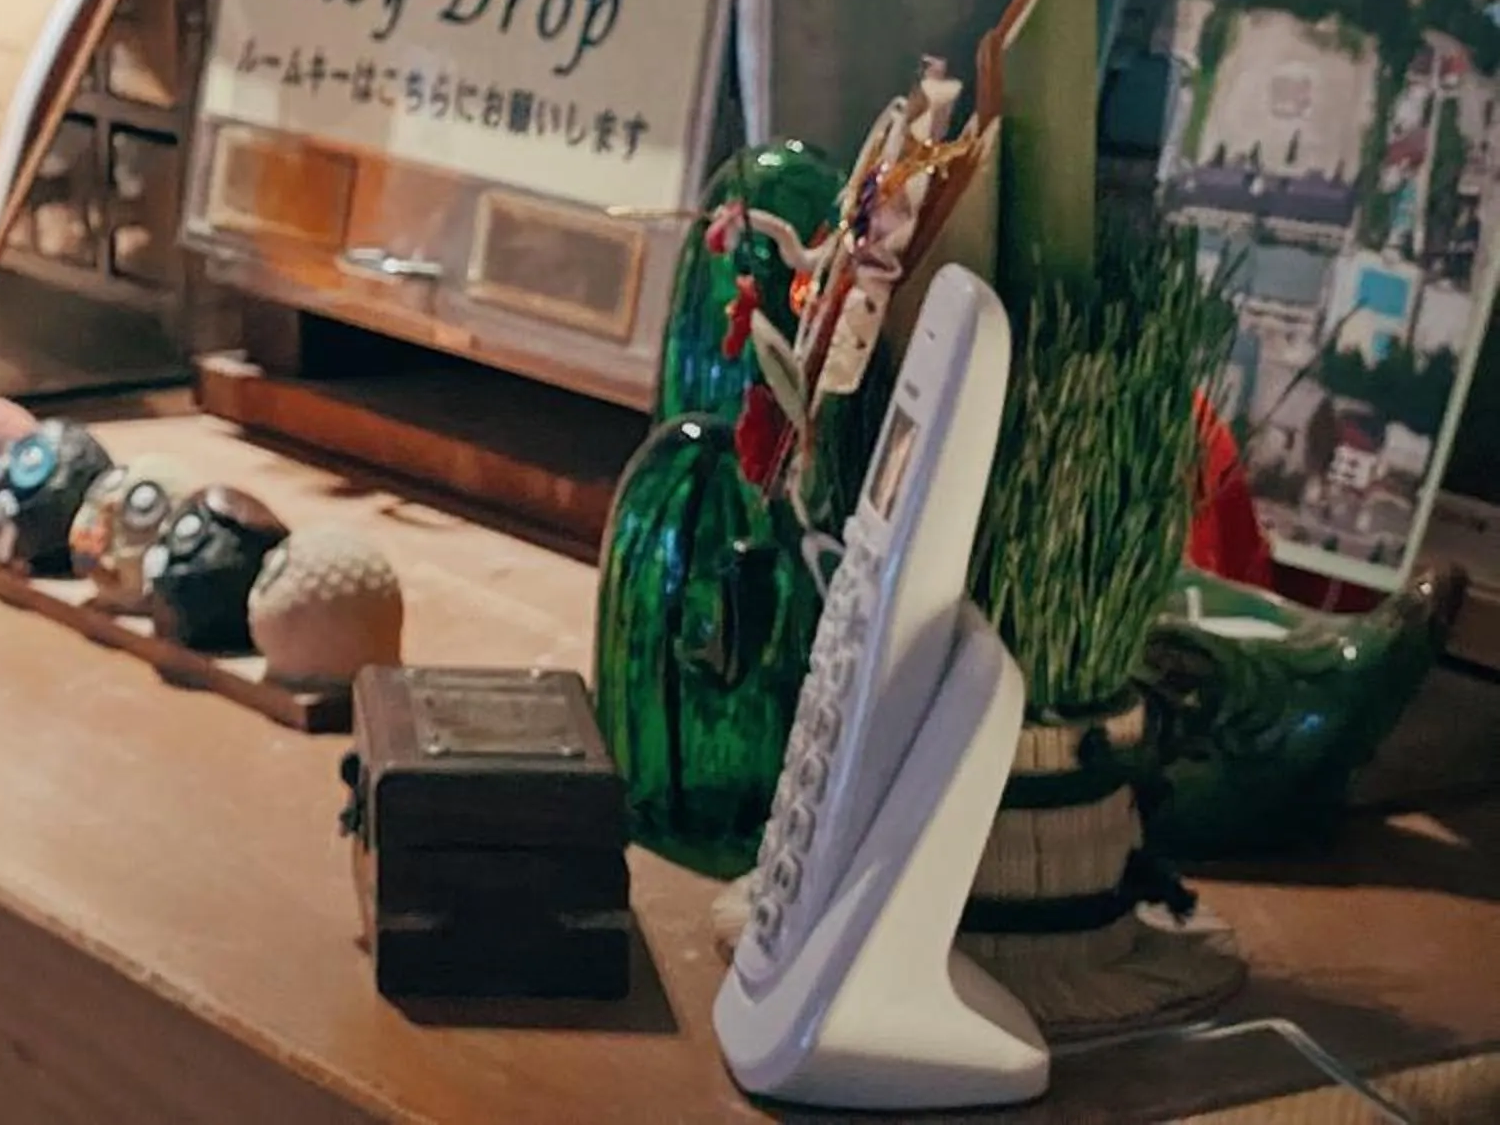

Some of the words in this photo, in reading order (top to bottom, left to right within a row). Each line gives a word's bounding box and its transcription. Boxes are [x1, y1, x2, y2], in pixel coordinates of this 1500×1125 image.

[237, 39, 649, 159] ルームキーはこちらにお願いします
